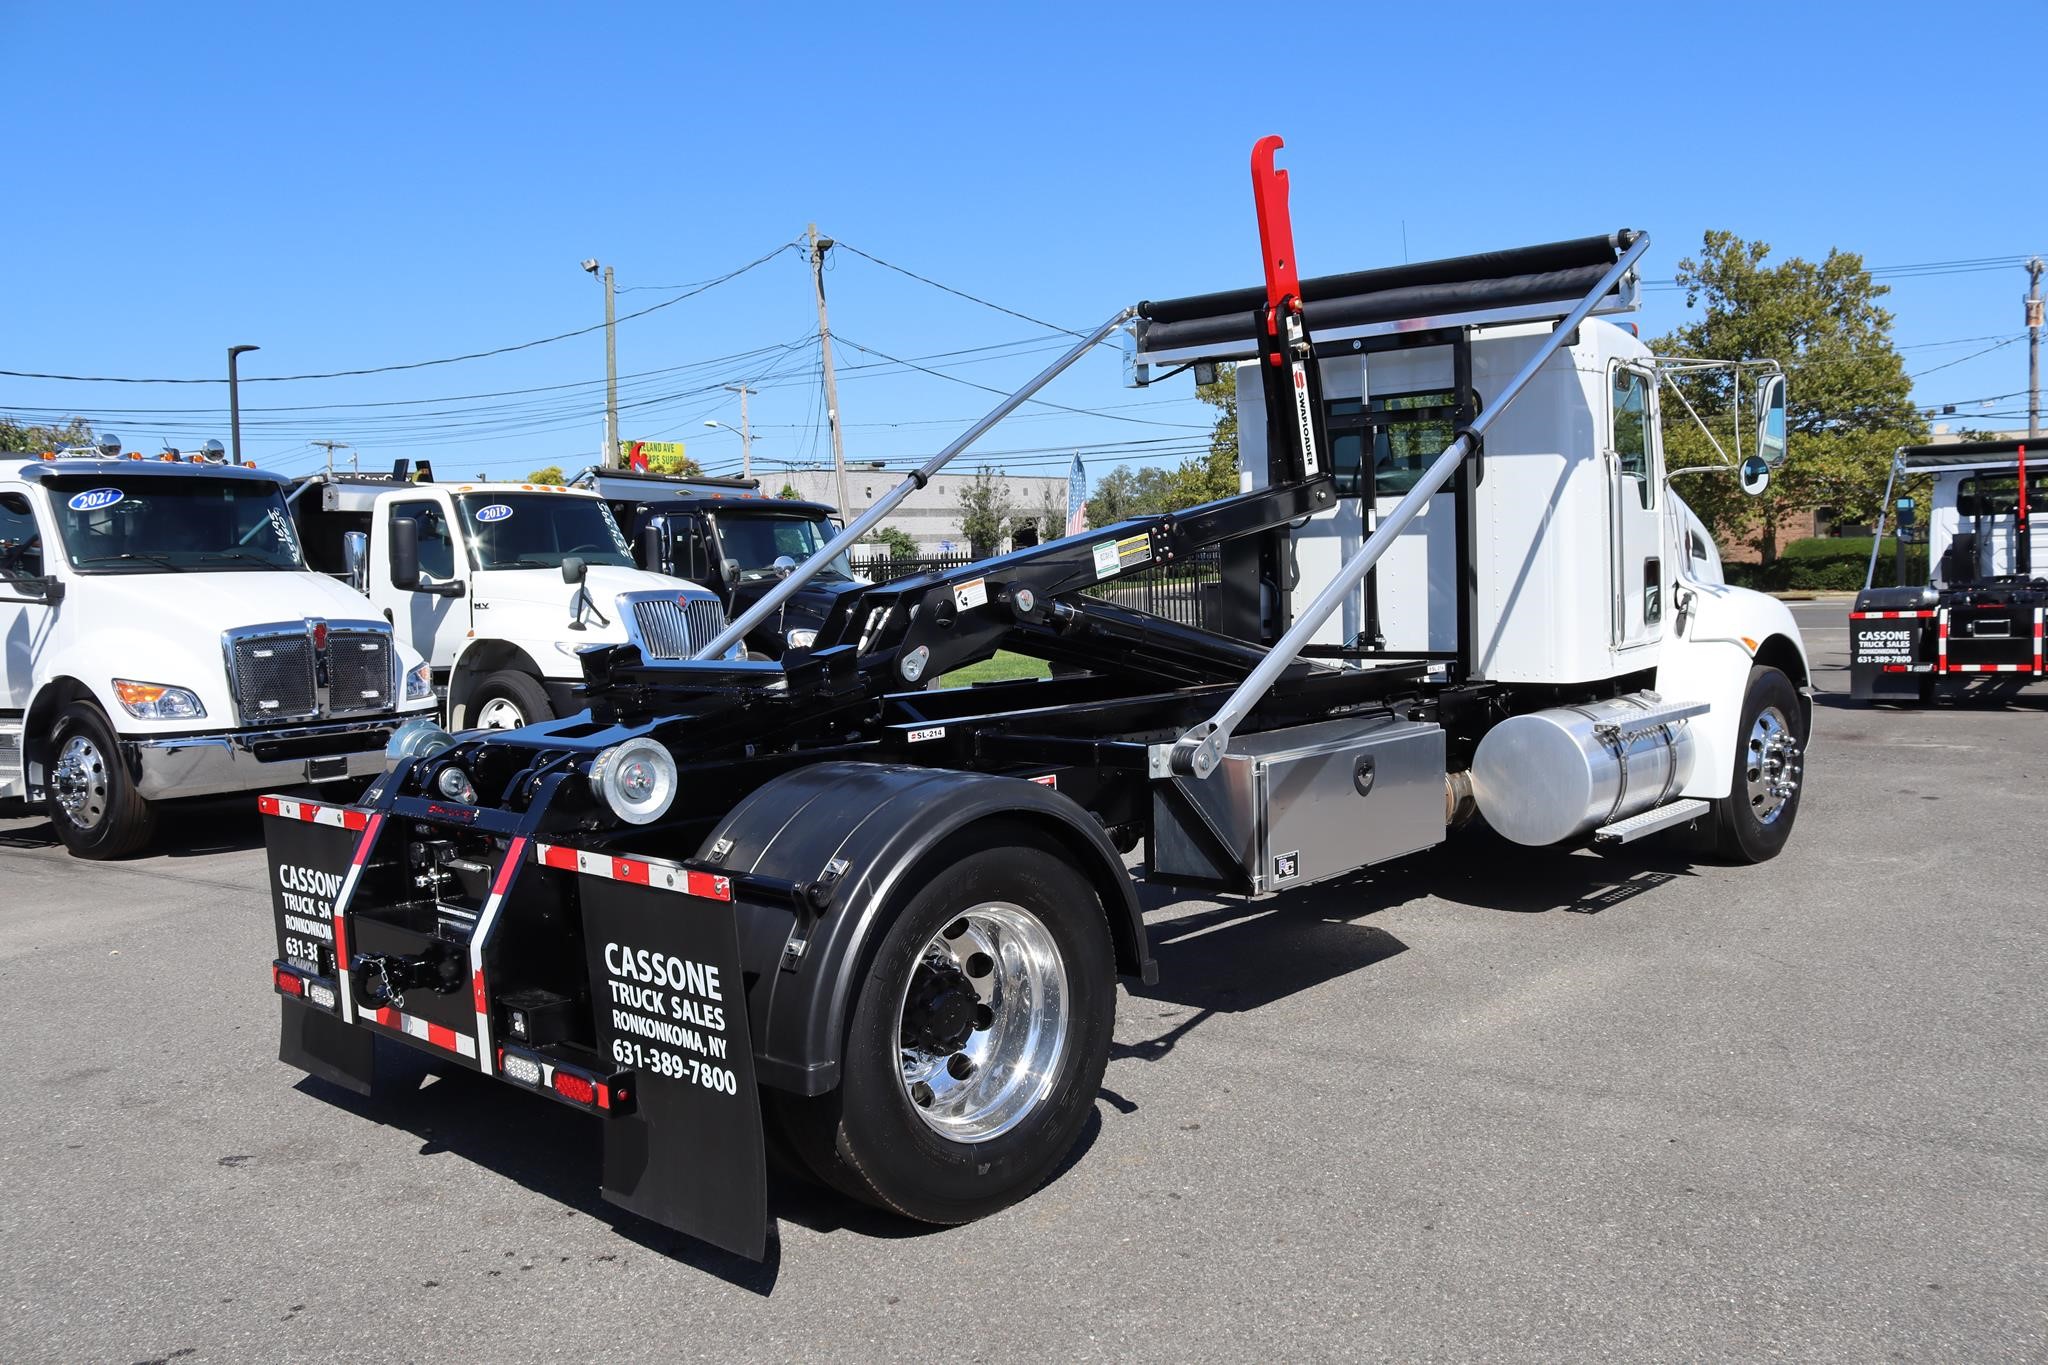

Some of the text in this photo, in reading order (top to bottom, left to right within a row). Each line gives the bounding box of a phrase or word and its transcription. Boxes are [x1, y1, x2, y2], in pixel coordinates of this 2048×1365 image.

[1298, 392, 1314, 466] SWAPLOADER
[663, 443, 675, 453] AVE
[80, 490, 113, 508] 2027
[484, 506, 507, 520] 2019
[1858, 631, 1911, 641] CASSONE
[917, 729, 942, 740] SL-214
[282, 892, 332, 920] TRUCK SA
[285, 914, 333, 940] RONKONKOM
[605, 942, 723, 1002] CASSONE
[608, 979, 726, 1031] TRUCK SALES
[612, 1009, 727, 1060] RONKONKOMA, NY
[612, 1038, 737, 1096] 631-389-7800
